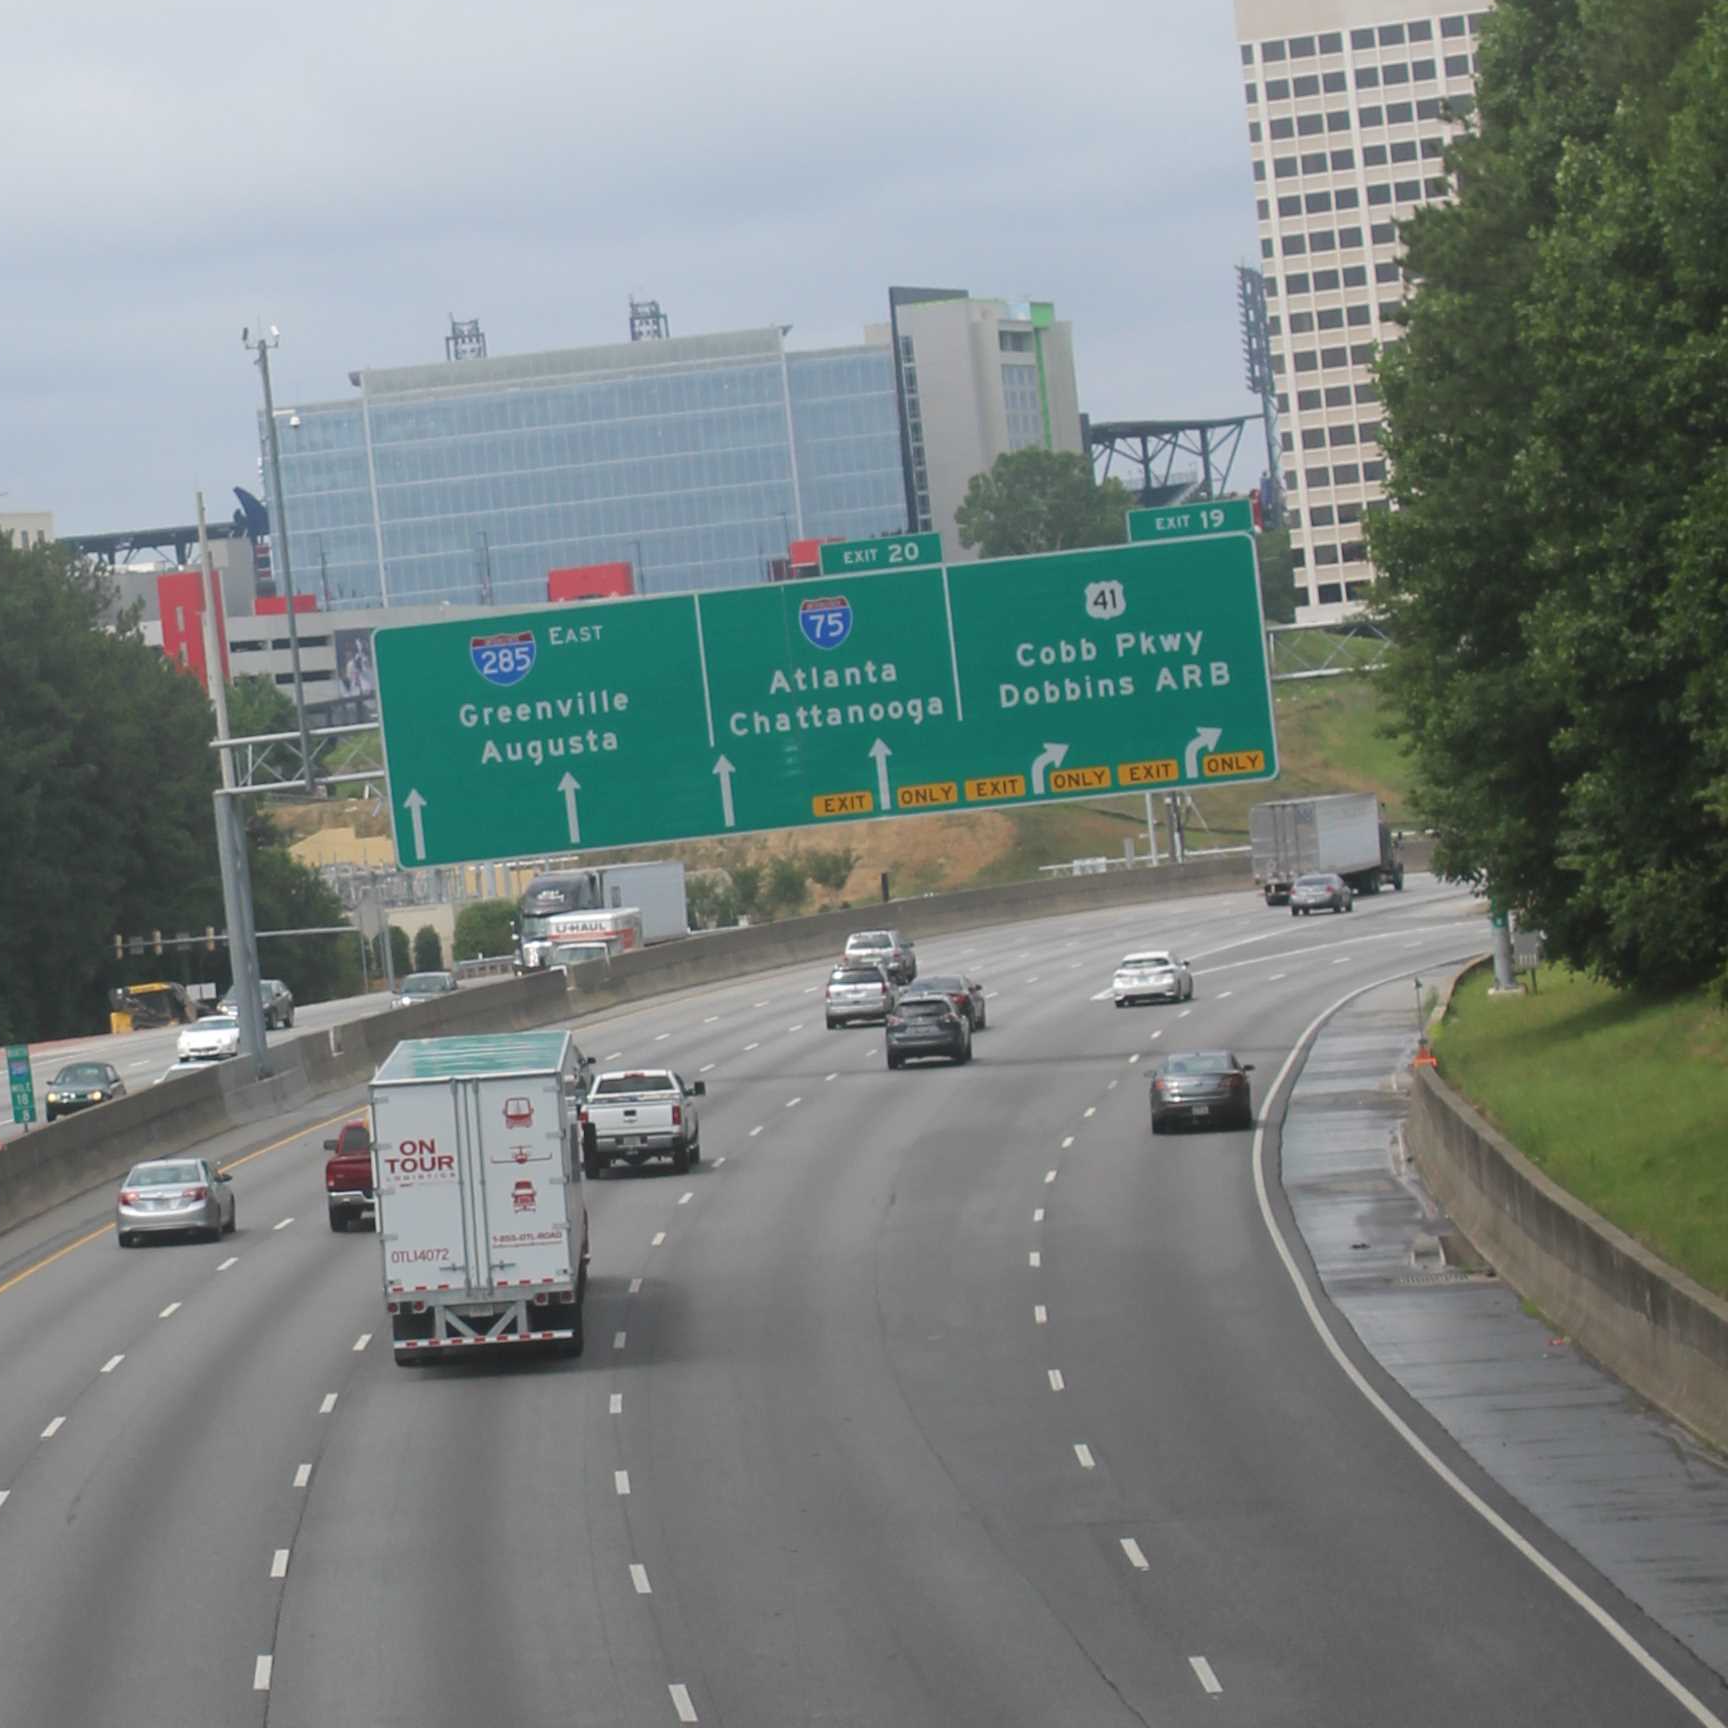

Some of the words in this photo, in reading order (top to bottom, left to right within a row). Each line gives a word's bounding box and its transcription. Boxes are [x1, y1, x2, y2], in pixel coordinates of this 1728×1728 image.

[1154, 514, 1191, 531] EXIT
[1200, 509, 1225, 529] 19
[843, 548, 879, 564] EXIT
[888, 542, 920, 563] 20
[1093, 588, 1118, 611] 41
[548, 625, 604, 646] EAST
[809, 612, 845, 639] 75
[480, 646, 532, 675] 285
[1015, 638, 1098, 668] Cobb
[1115, 629, 1204, 657] Pkwy
[769, 660, 898, 695] Atlanta
[998, 674, 1135, 709] Dobbins
[1155, 661, 1231, 693] ARB
[459, 689, 630, 728] Greenville
[729, 695, 945, 737] Chattanooga
[481, 729, 619, 766] Augusta
[824, 794, 867, 813] EXIT
[900, 785, 954, 806] ONLY
[976, 778, 1019, 798] EXIT
[1053, 770, 1106, 790] ONLY
[1129, 763, 1172, 782] EXIT
[1206, 753, 1259, 774] ONLY
[556, 922, 606, 933] U-HAUL
[399, 1139, 436, 1156] ON
[384, 1155, 455, 1174] TOUR
